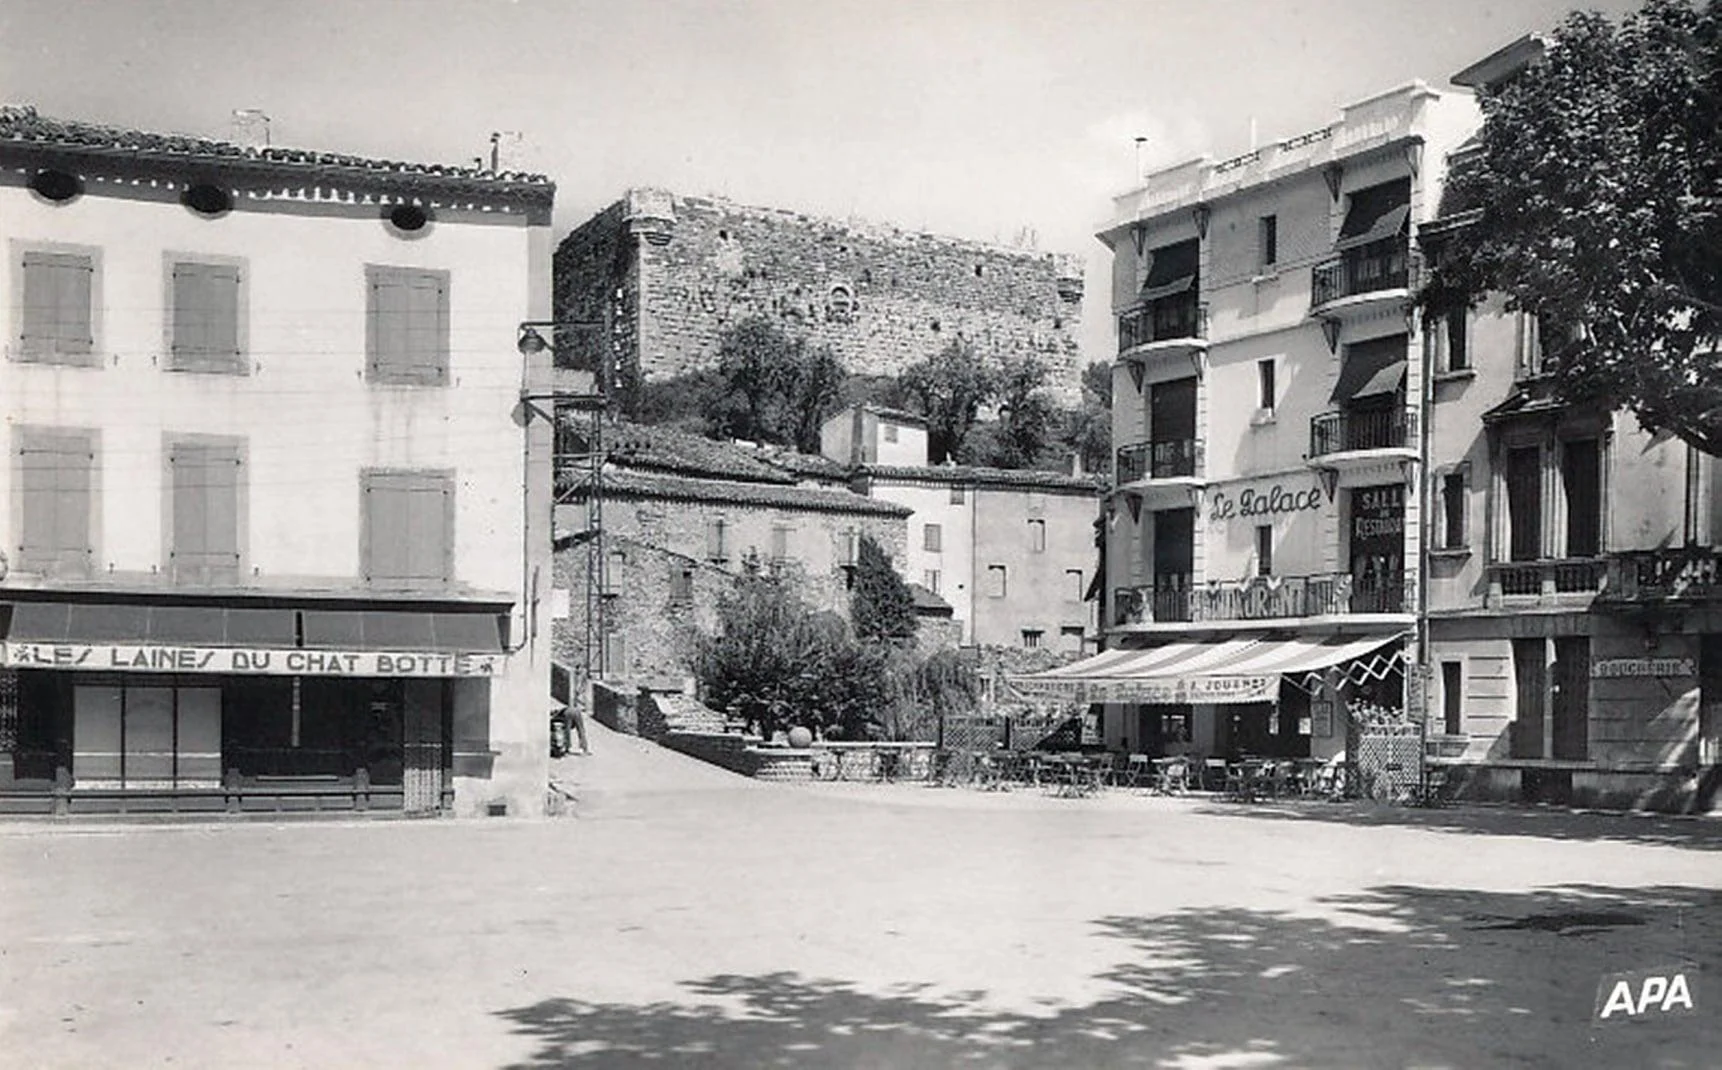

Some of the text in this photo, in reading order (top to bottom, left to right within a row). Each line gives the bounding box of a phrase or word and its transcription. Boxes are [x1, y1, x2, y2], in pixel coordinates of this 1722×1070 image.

[1211, 485, 1322, 520] Le Palace
[1362, 489, 1401, 510] SALL
[34, 647, 92, 665] LES
[112, 649, 214, 668] LAINES
[232, 652, 270, 669] DU
[287, 653, 360, 672] CHAT
